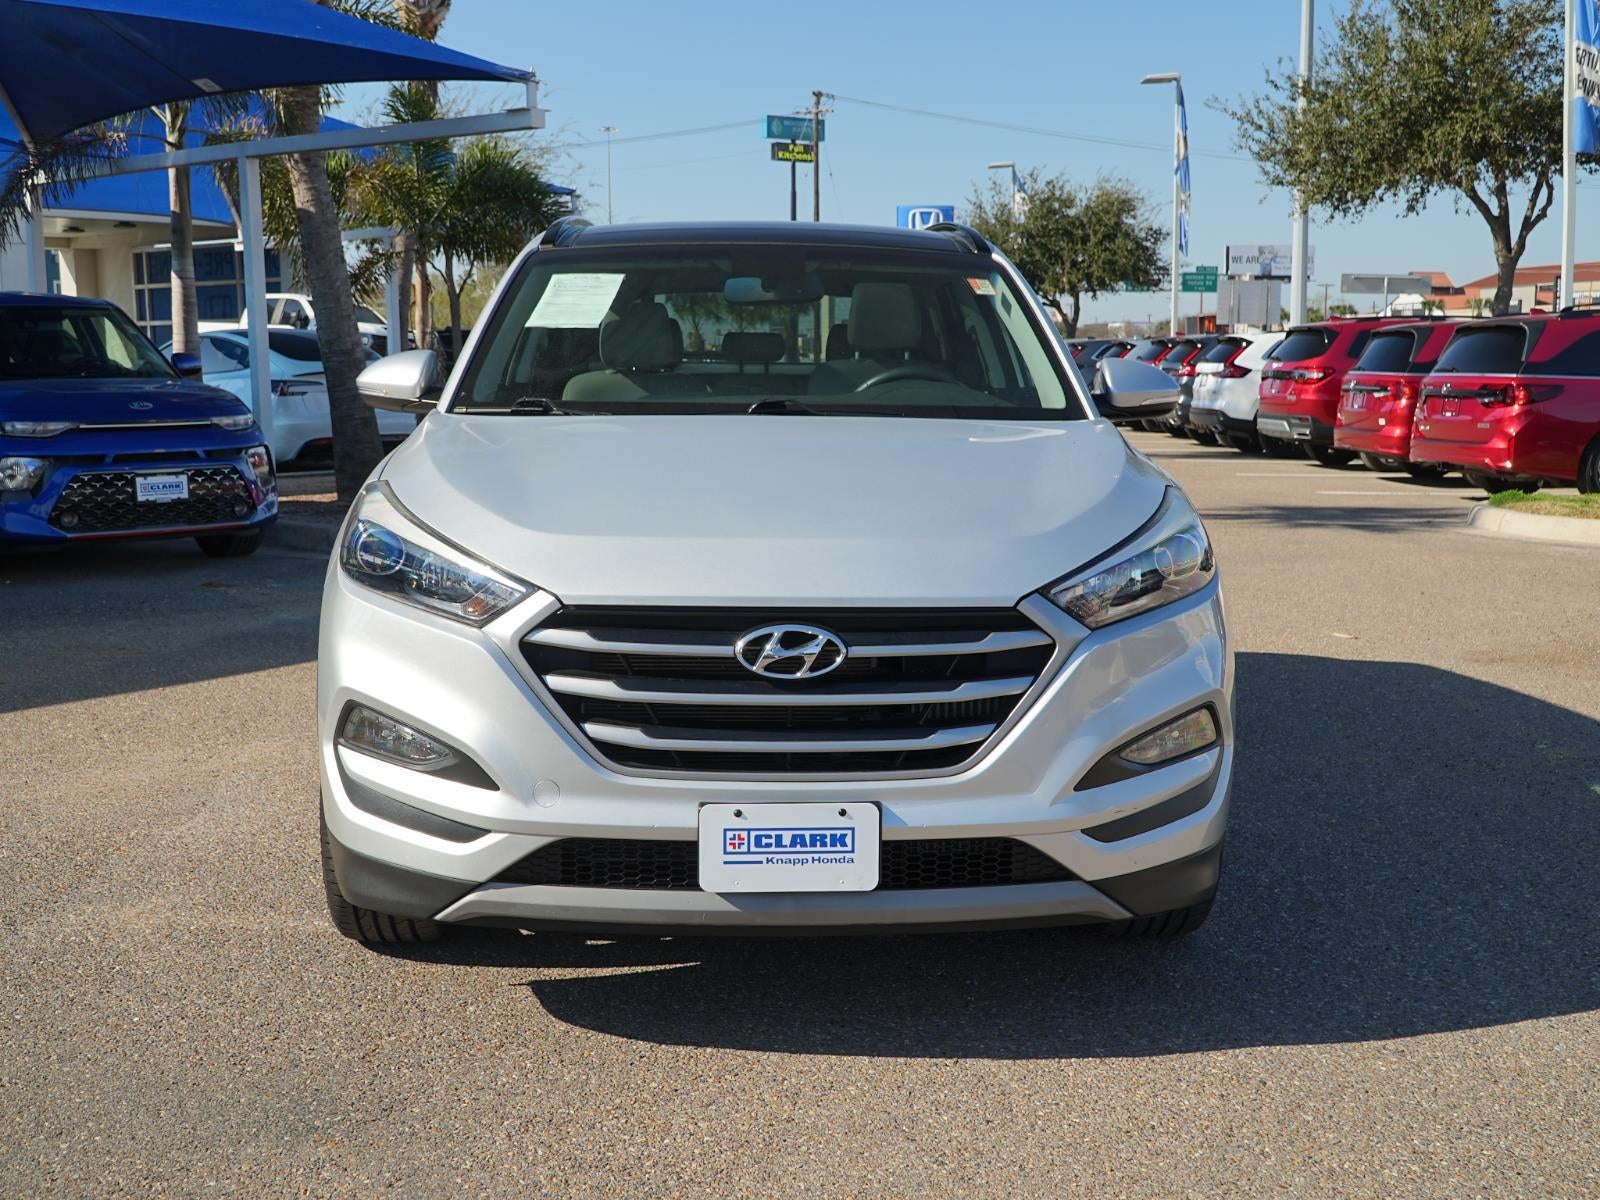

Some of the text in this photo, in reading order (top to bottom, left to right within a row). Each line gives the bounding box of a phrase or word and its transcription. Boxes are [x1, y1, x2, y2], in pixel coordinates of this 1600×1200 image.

[789, 144, 803, 152] Full
[1231, 256, 1244, 264] WE
[753, 832, 849, 849] CLARK
[765, 856, 855, 866] Knapp Honda
